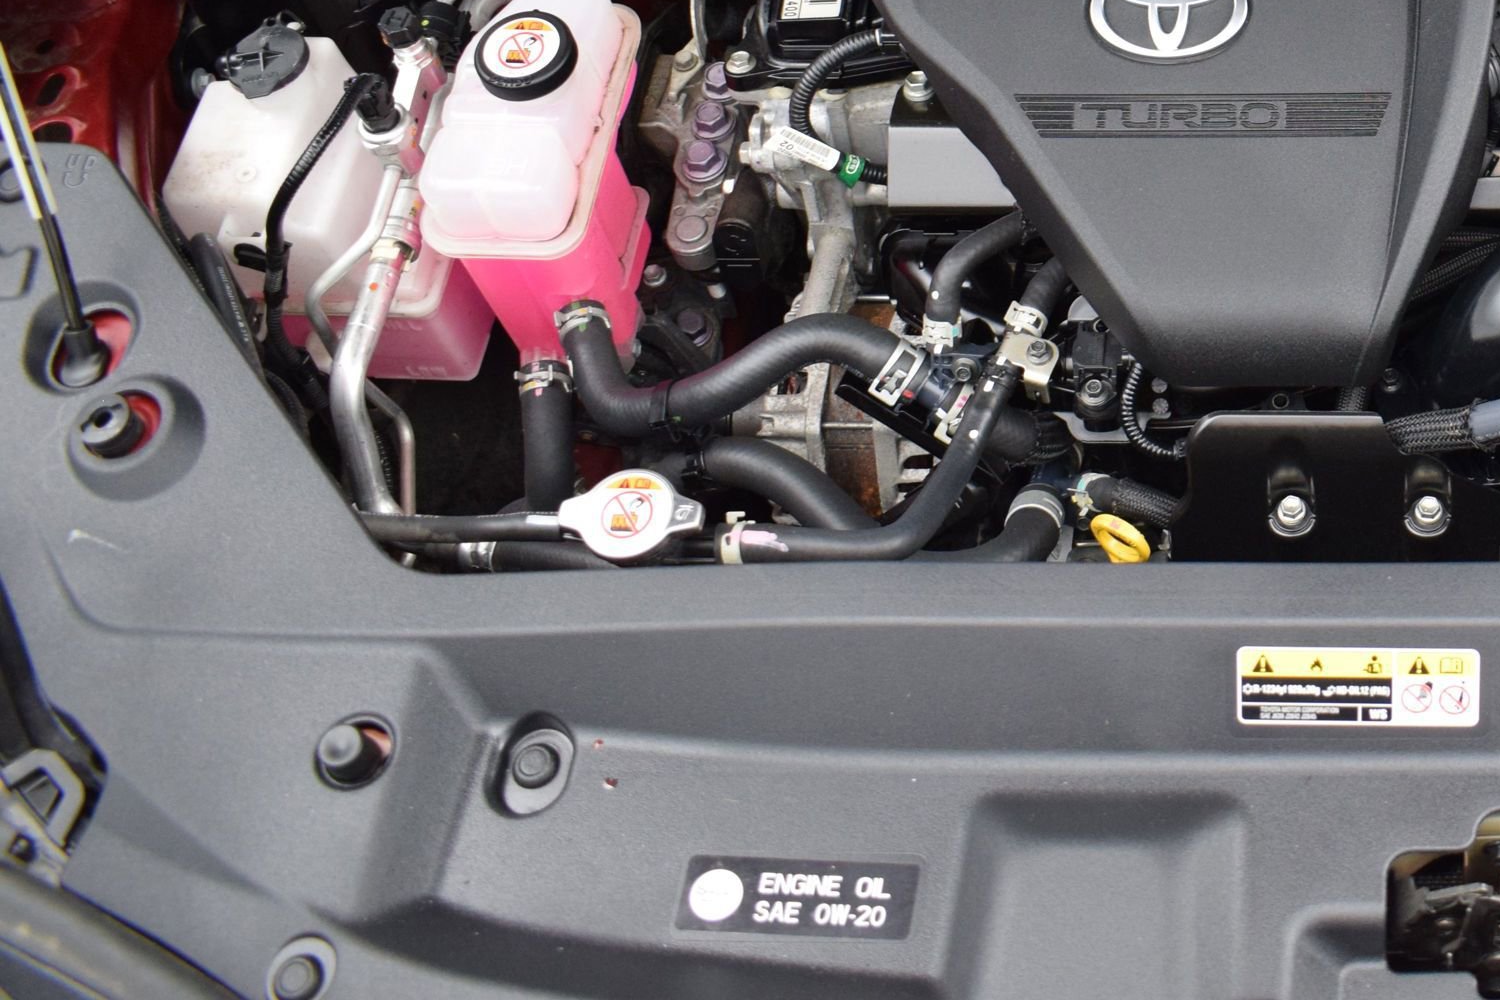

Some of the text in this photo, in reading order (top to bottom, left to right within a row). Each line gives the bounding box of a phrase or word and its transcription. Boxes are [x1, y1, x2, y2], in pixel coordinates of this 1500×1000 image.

[784, 0, 798, 16] 400
[1080, 102, 1280, 130] TURBO
[758, 872, 891, 899] ENGINE OIL
[753, 900, 887, 928] SAE 0W-20
